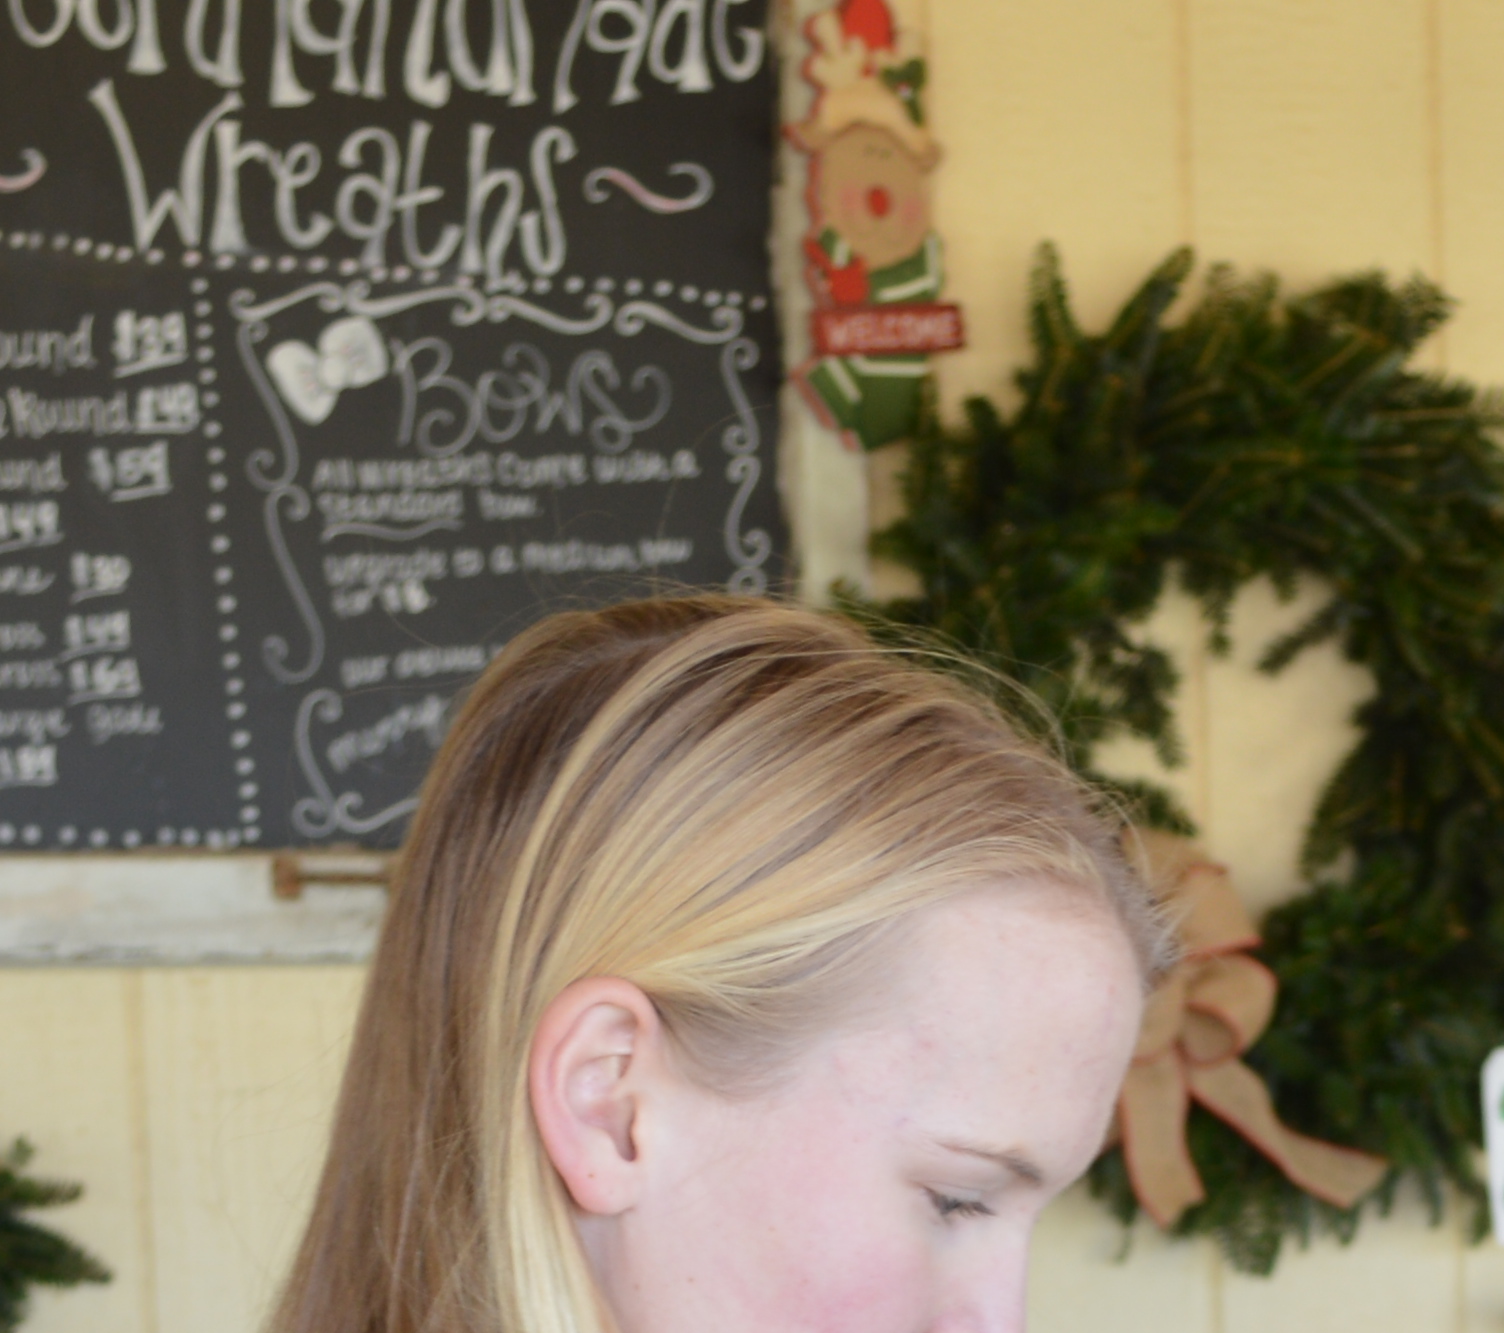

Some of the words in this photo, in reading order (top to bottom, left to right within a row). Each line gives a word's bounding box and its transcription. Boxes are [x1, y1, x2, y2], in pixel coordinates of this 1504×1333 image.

[89, 80, 577, 288] Wreaths
[823, 311, 960, 349] WELCOME
[7, 386, 135, 438] Round
[391, 335, 672, 458] Bows
